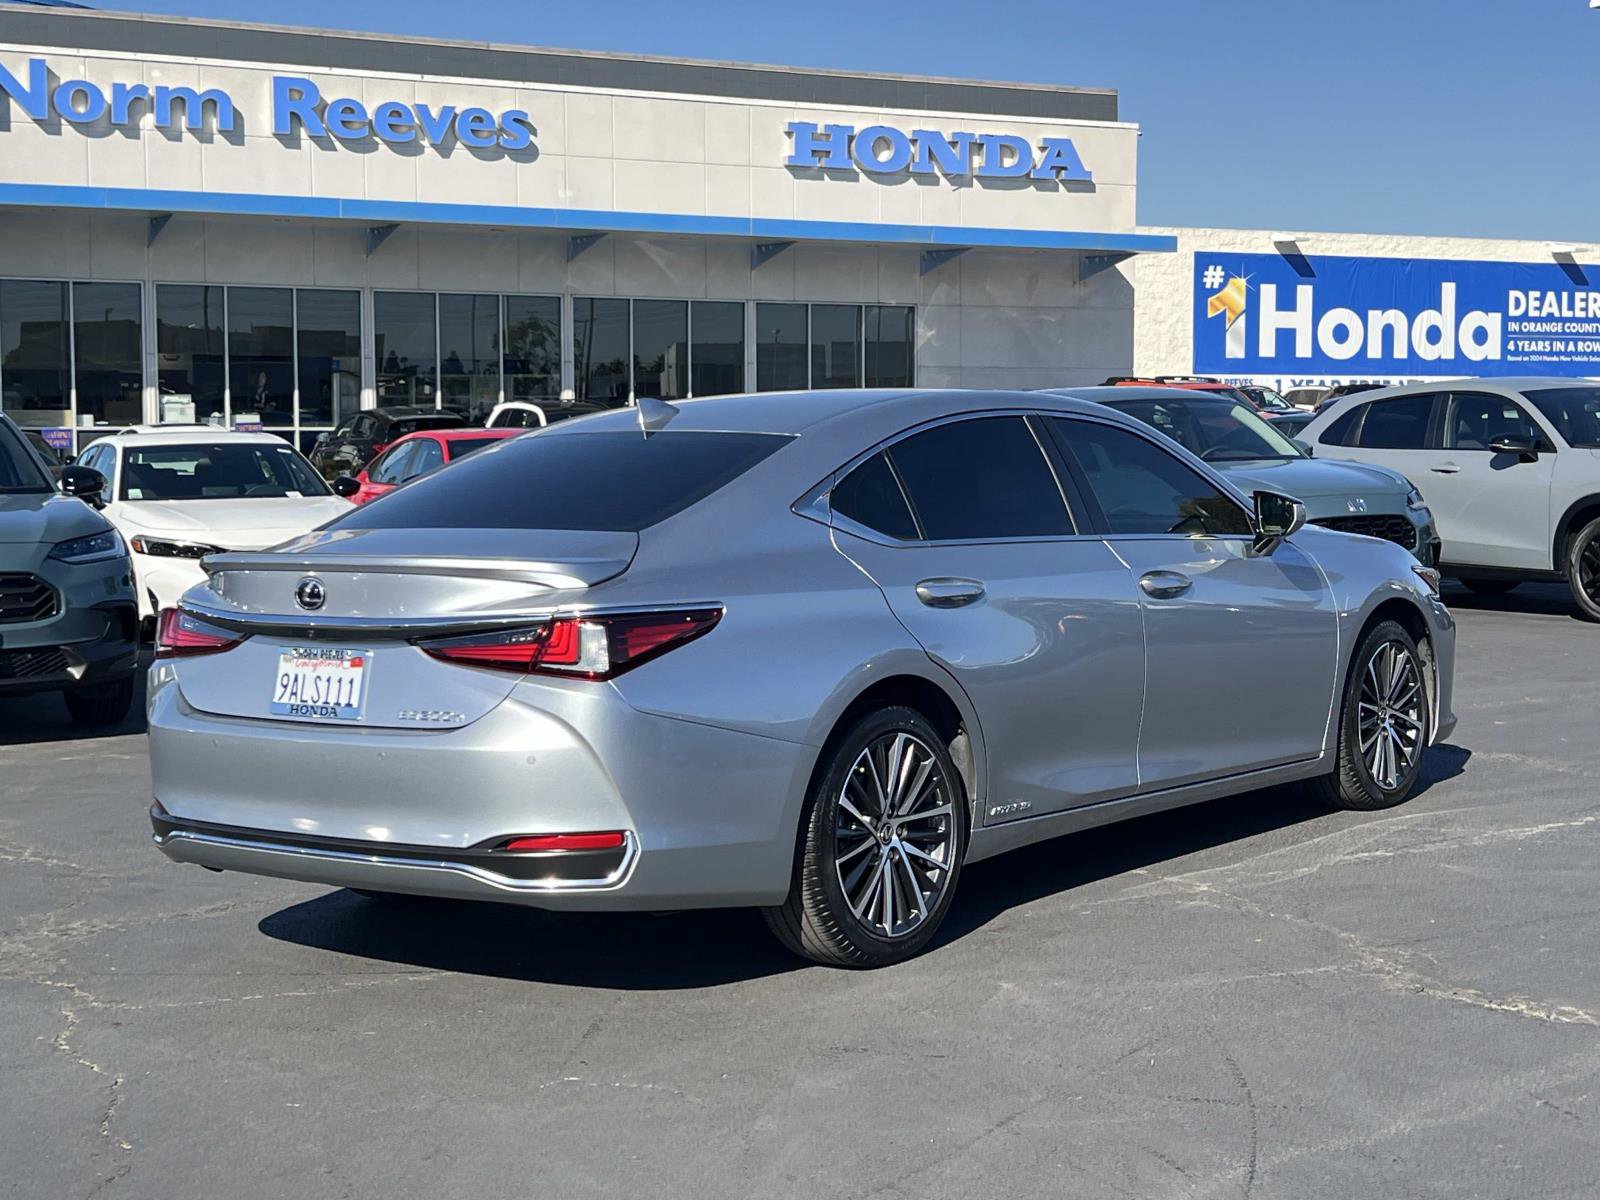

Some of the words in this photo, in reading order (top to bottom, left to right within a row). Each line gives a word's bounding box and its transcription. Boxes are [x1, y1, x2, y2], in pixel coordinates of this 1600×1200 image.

[0, 58, 234, 131] Norm
[272, 76, 530, 150] Reeves
[786, 121, 1094, 182] HONDA
[1508, 290, 1600, 318] DEALER
[1259, 282, 1502, 361] Honda
[1508, 321, 1519, 332] IN
[1521, 321, 1562, 333] ORANGE
[1564, 322, 1600, 333] COUNTY
[1507, 340, 1515, 352] 4
[1517, 340, 1550, 352] YEARS
[1553, 340, 1565, 352] IN
[1567, 341, 1576, 353] A
[278, 673, 354, 708] 9ALS111
[289, 704, 339, 717] HONDA
